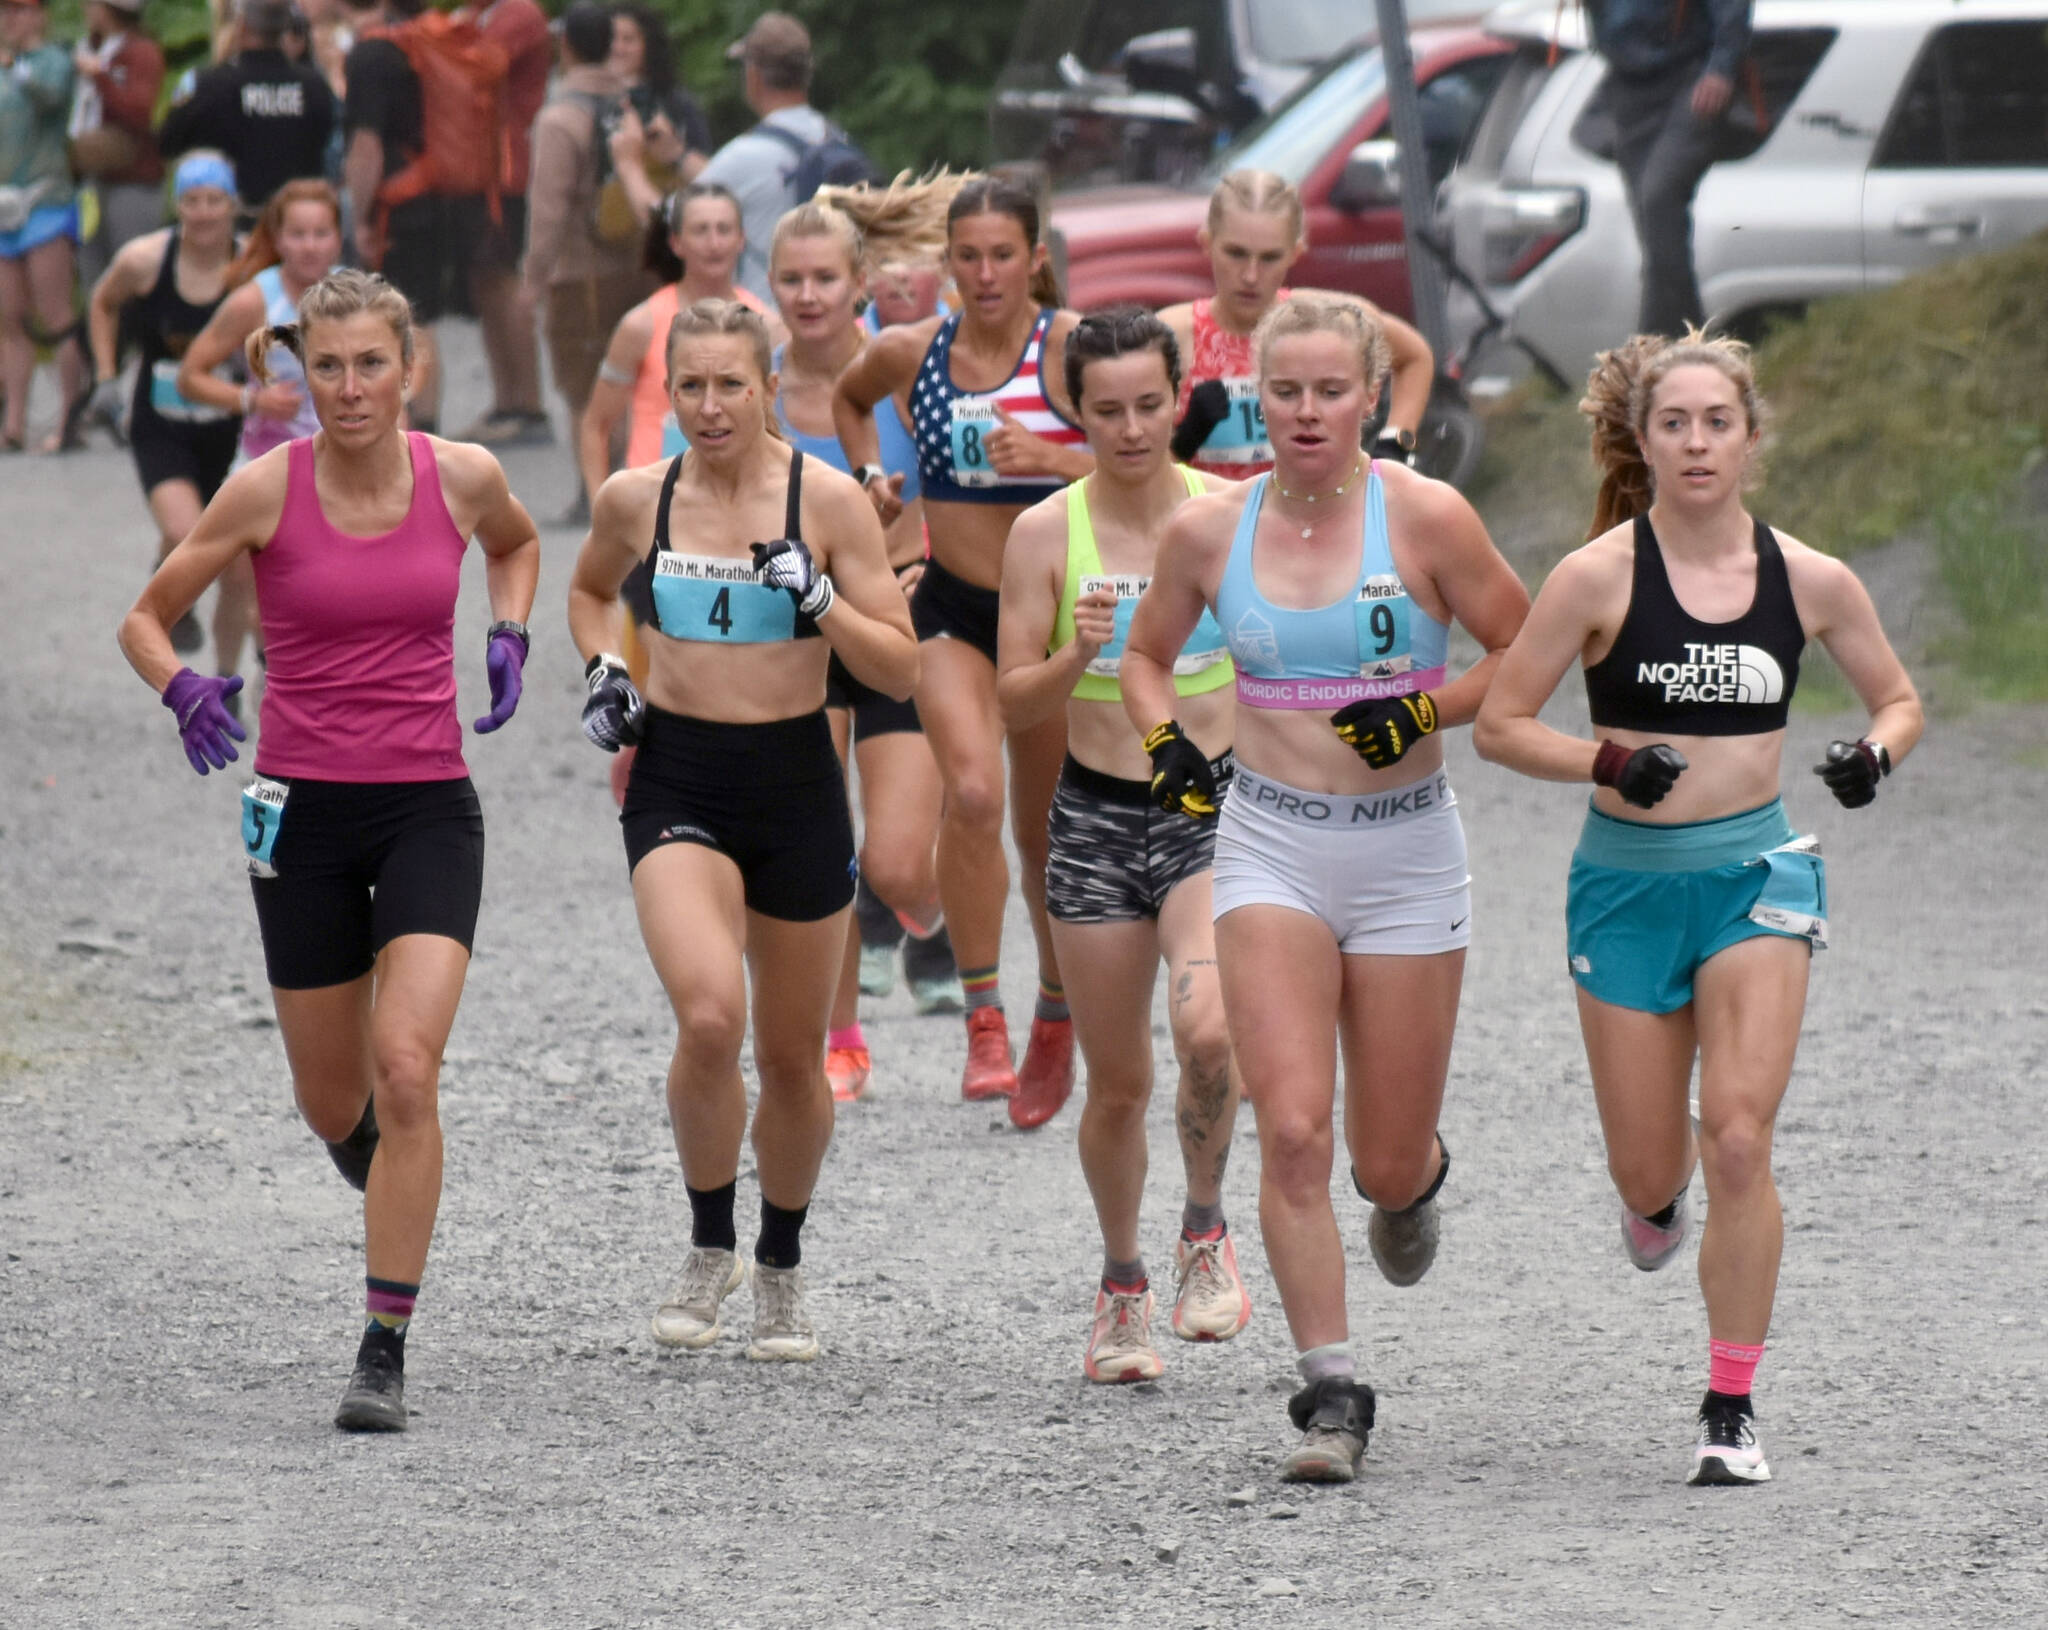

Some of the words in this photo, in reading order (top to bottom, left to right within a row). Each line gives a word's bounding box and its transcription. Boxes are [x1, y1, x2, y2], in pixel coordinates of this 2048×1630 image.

[962, 425, 981, 467] 8
[662, 558, 684, 576] 97th
[686, 561, 701, 578] Mt.
[705, 564, 759, 582] Marathon
[1116, 582, 1135, 596] Mt.
[708, 586, 733, 636] 4
[1370, 604, 1396, 655] 9
[1684, 643, 1737, 664] THE
[1637, 662, 1737, 685] NORTH
[1240, 679, 1293, 700] NORDIC
[1297, 679, 1414, 700] ENDURANCE
[1664, 683, 1735, 703] FACE
[1257, 784, 1331, 820] PRO
[1351, 786, 1432, 823] NIKE
[248, 803, 266, 852] 5
